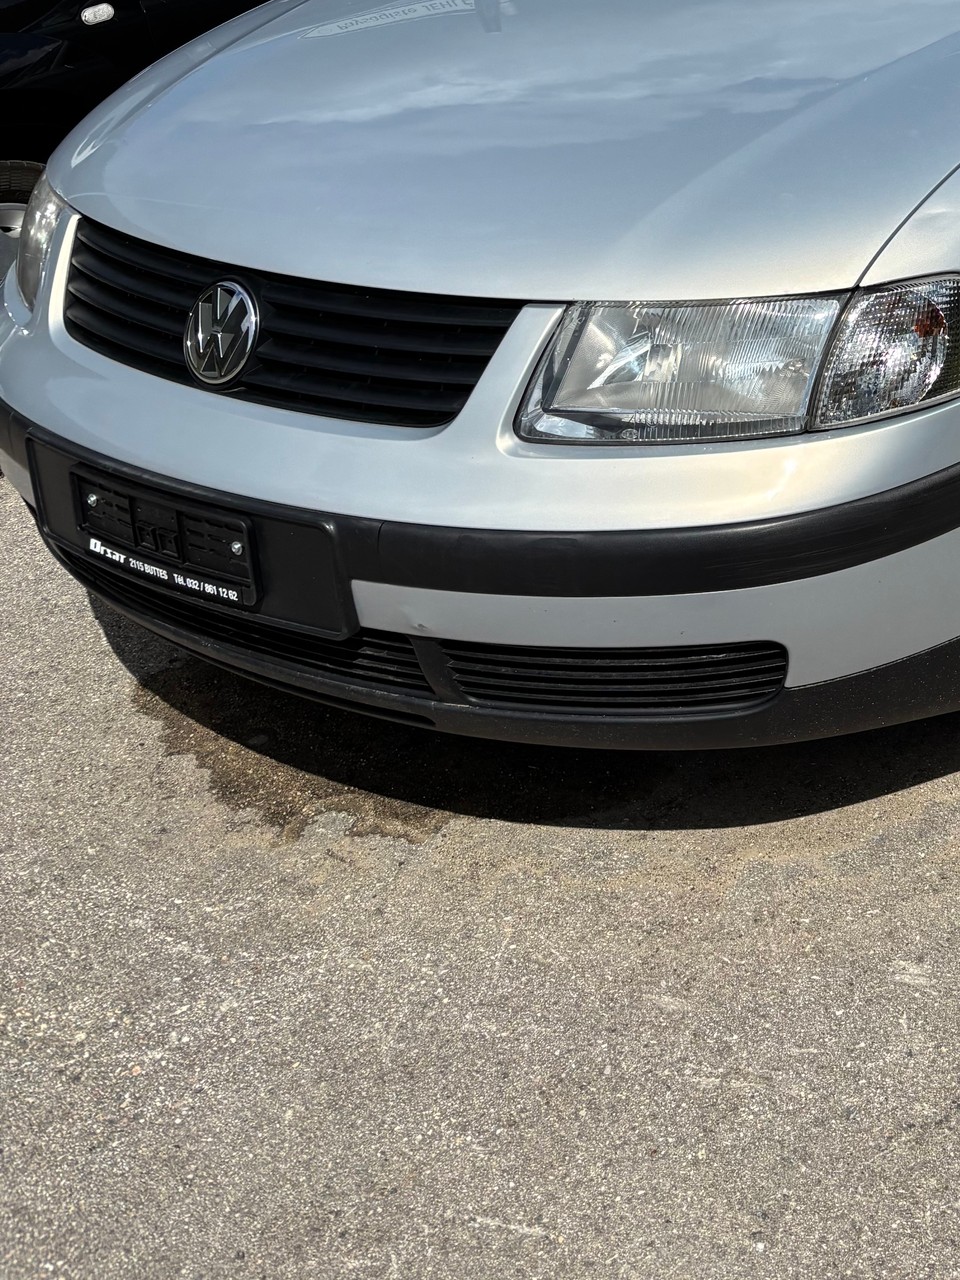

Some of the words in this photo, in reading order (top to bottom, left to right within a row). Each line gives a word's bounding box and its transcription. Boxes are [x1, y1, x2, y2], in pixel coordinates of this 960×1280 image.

[128, 558, 144, 571] 2115
[144, 563, 169, 580] BUTTES
[186, 578, 200, 590] 032
[204, 583, 217, 595] 861
[218, 587, 228, 598] 12
[228, 590, 239, 601] 62
